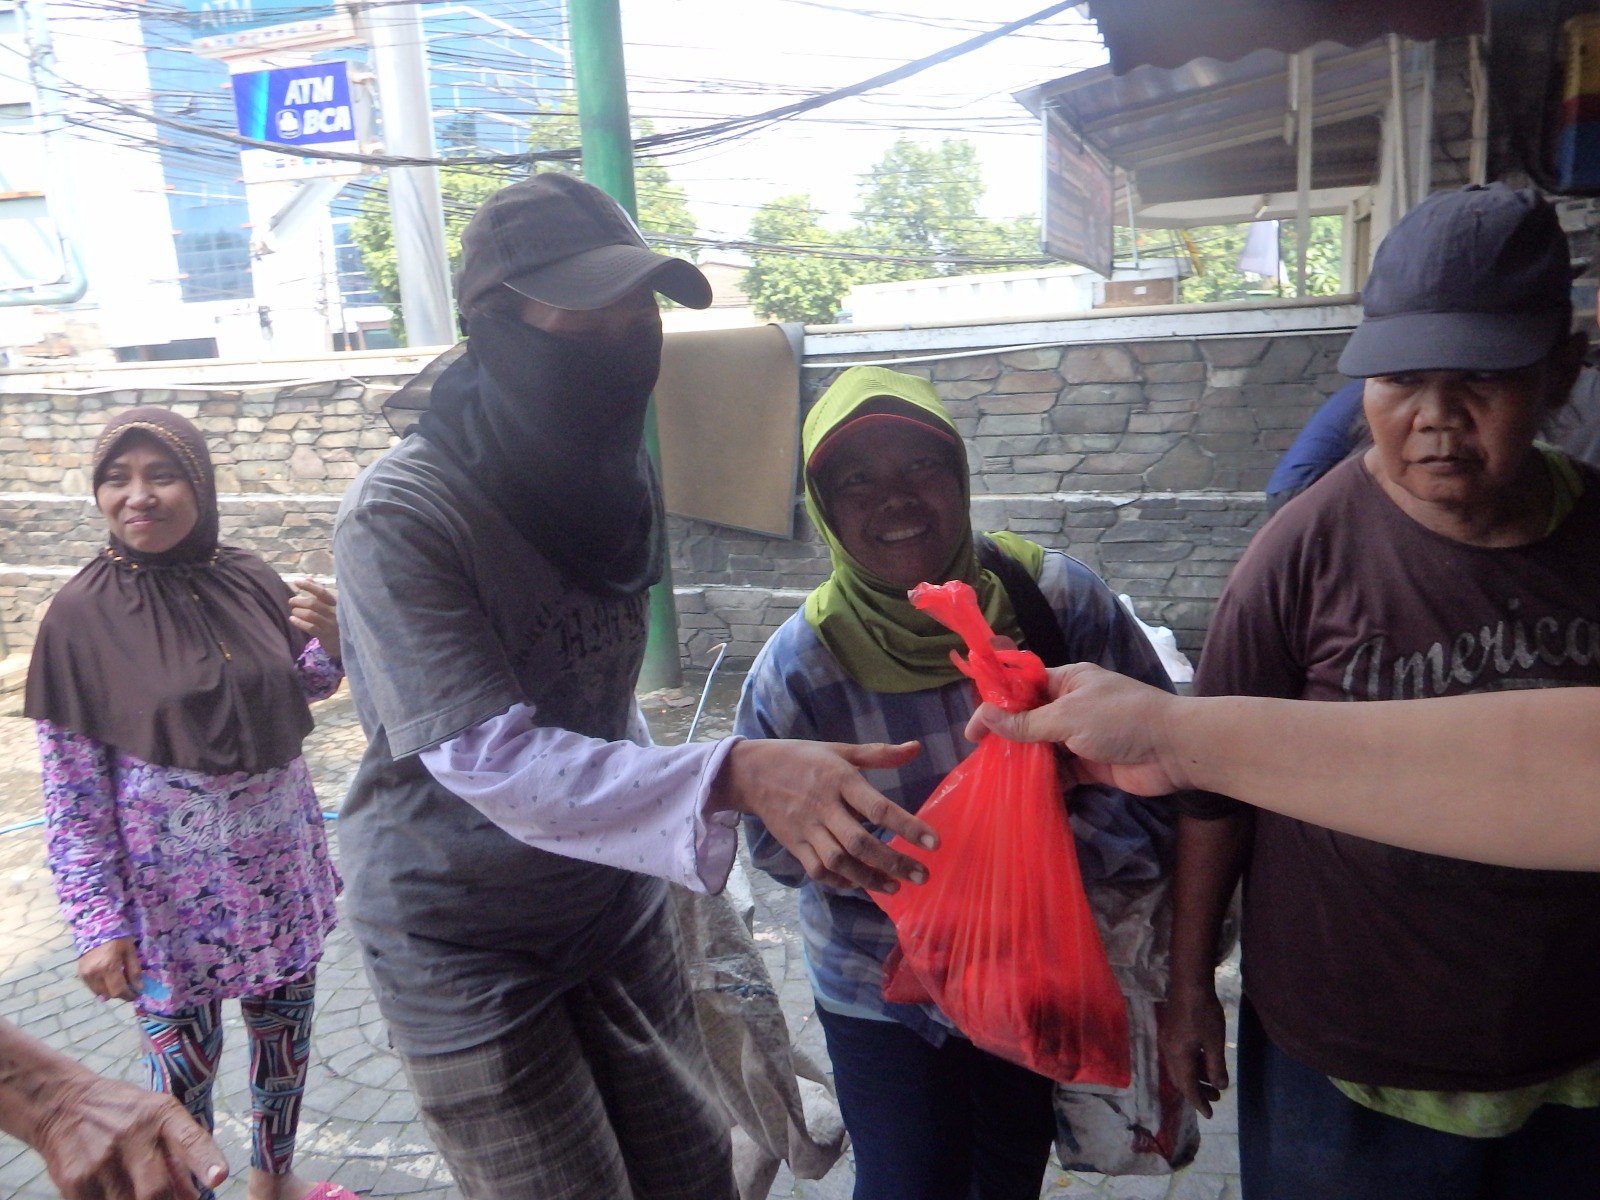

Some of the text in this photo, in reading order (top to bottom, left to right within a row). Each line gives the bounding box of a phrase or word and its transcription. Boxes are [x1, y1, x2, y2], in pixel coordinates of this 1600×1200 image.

[200, 0, 253, 28] ATM
[284, 75, 334, 106] ATM
[303, 105, 352, 134] BCA
[1341, 599, 1600, 700] America
